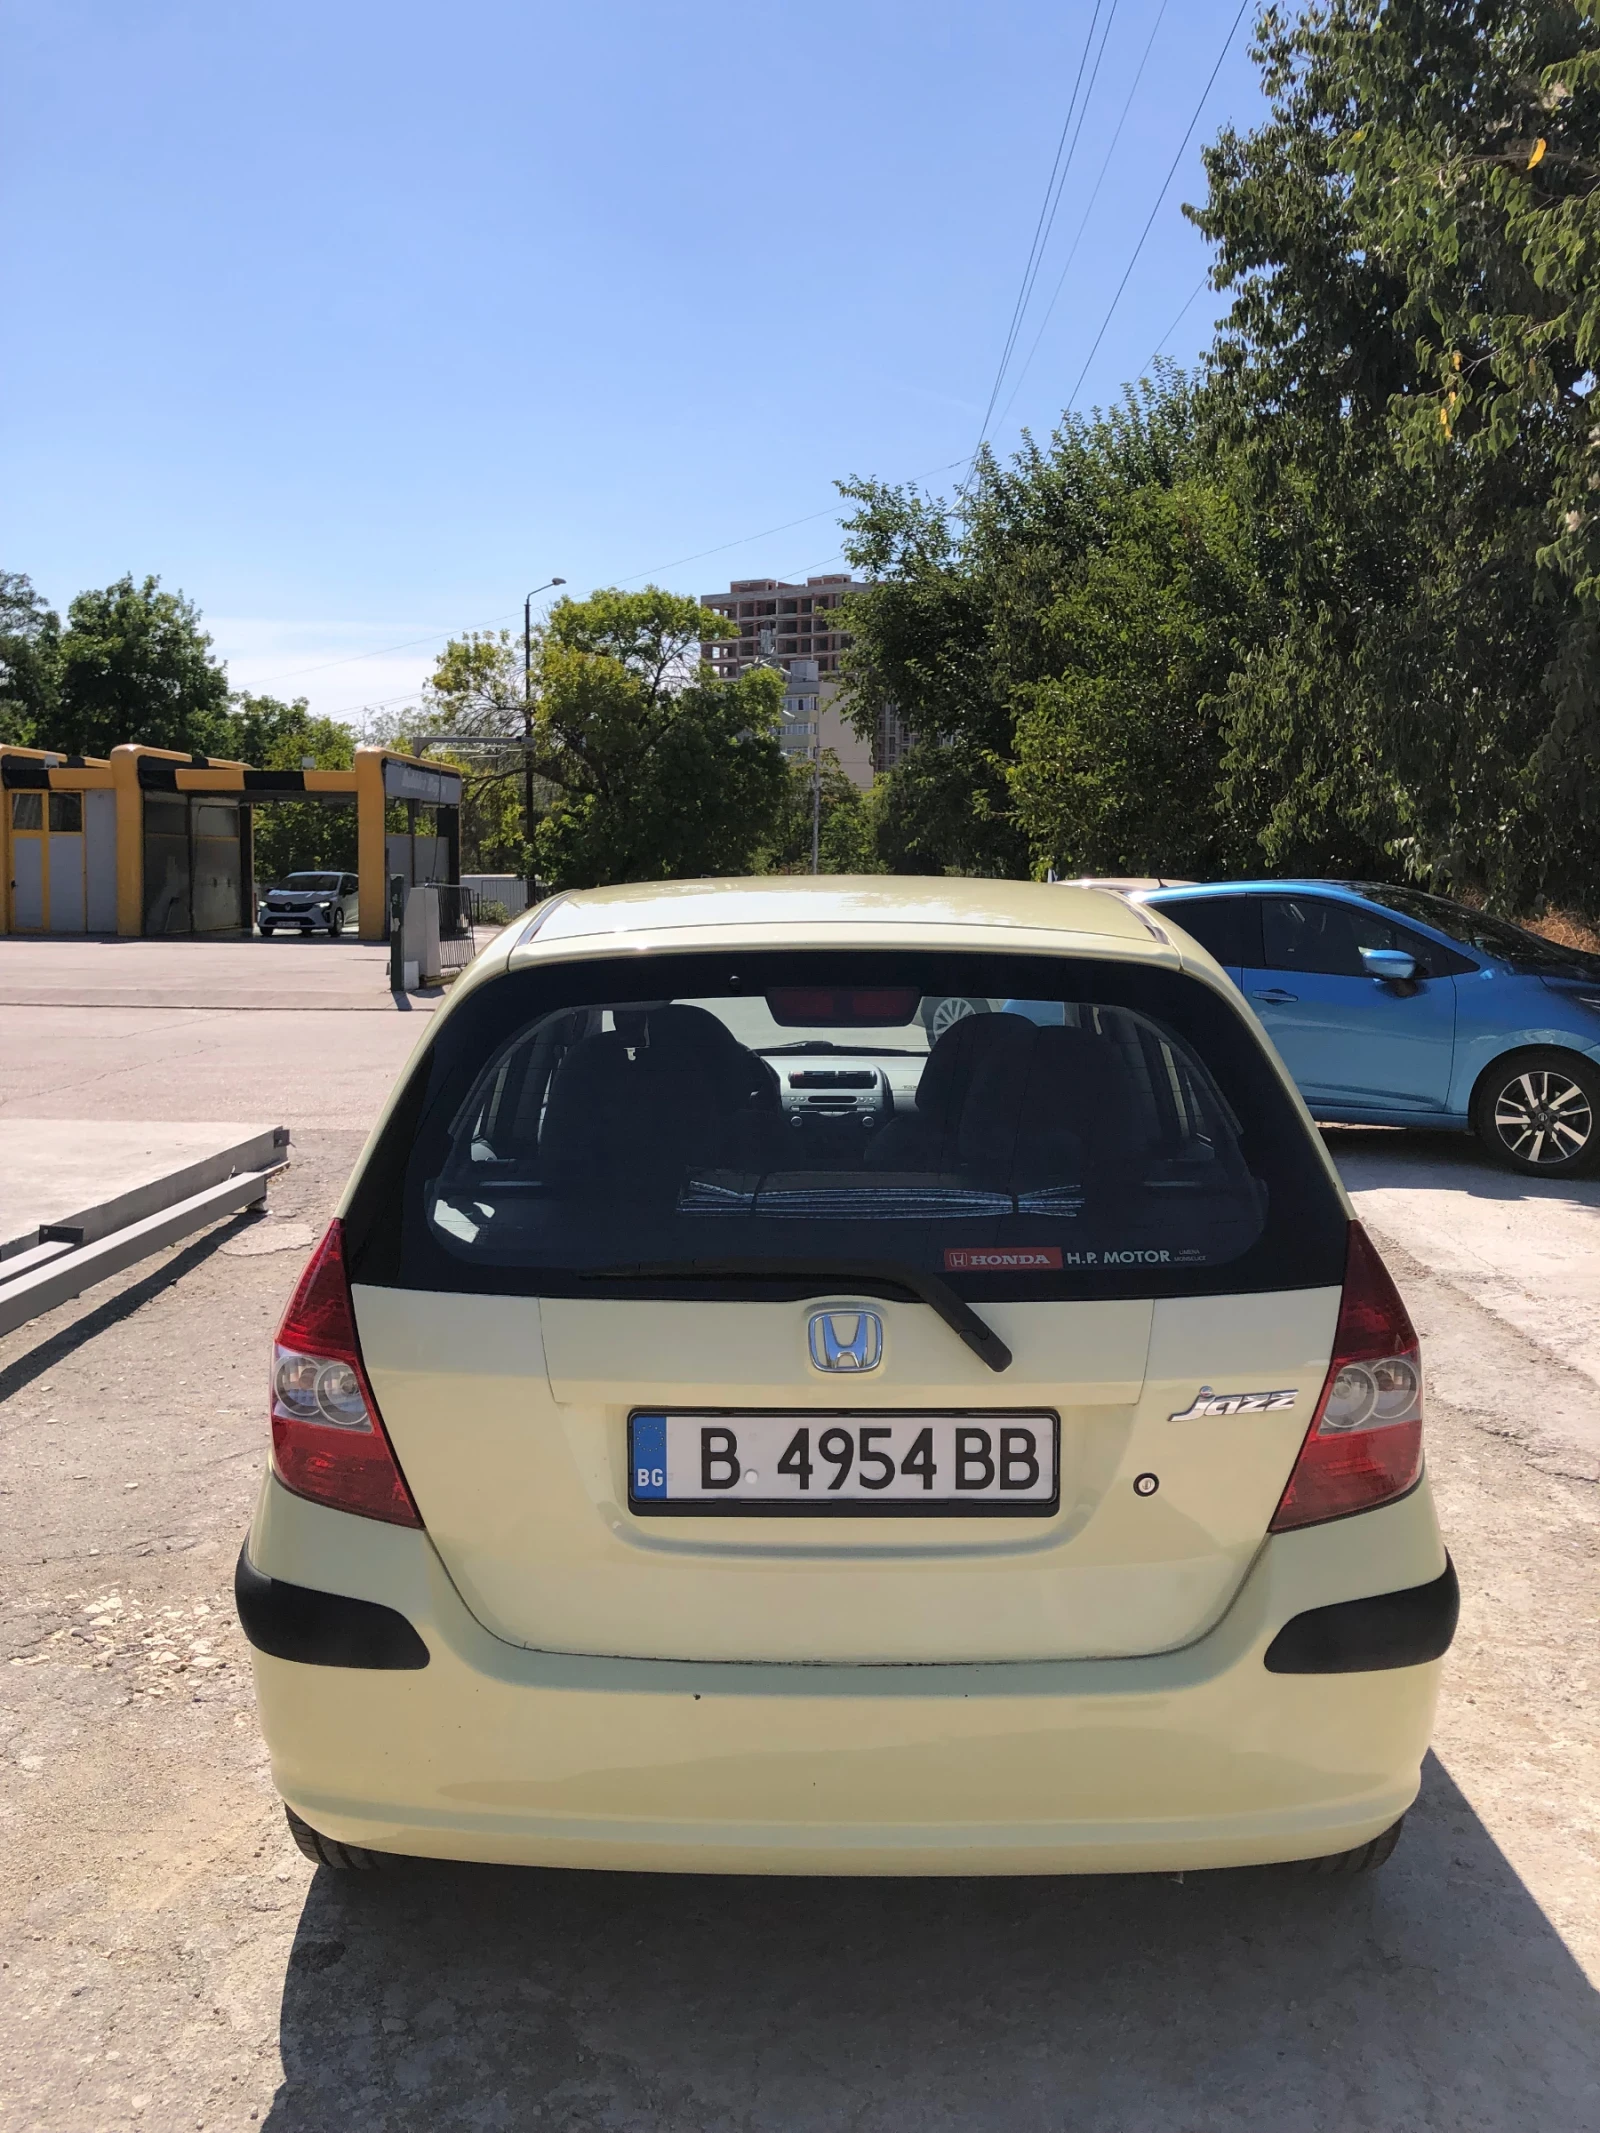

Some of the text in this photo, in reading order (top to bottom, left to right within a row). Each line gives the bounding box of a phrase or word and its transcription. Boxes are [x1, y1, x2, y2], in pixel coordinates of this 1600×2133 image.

[970, 1254, 1051, 1266] HONDA
[1066, 1250, 1098, 1265] H.P.
[1103, 1249, 1171, 1264] MOTOR
[700, 1427, 1040, 1490] B 4954 BB
[637, 1468, 664, 1488] BG
